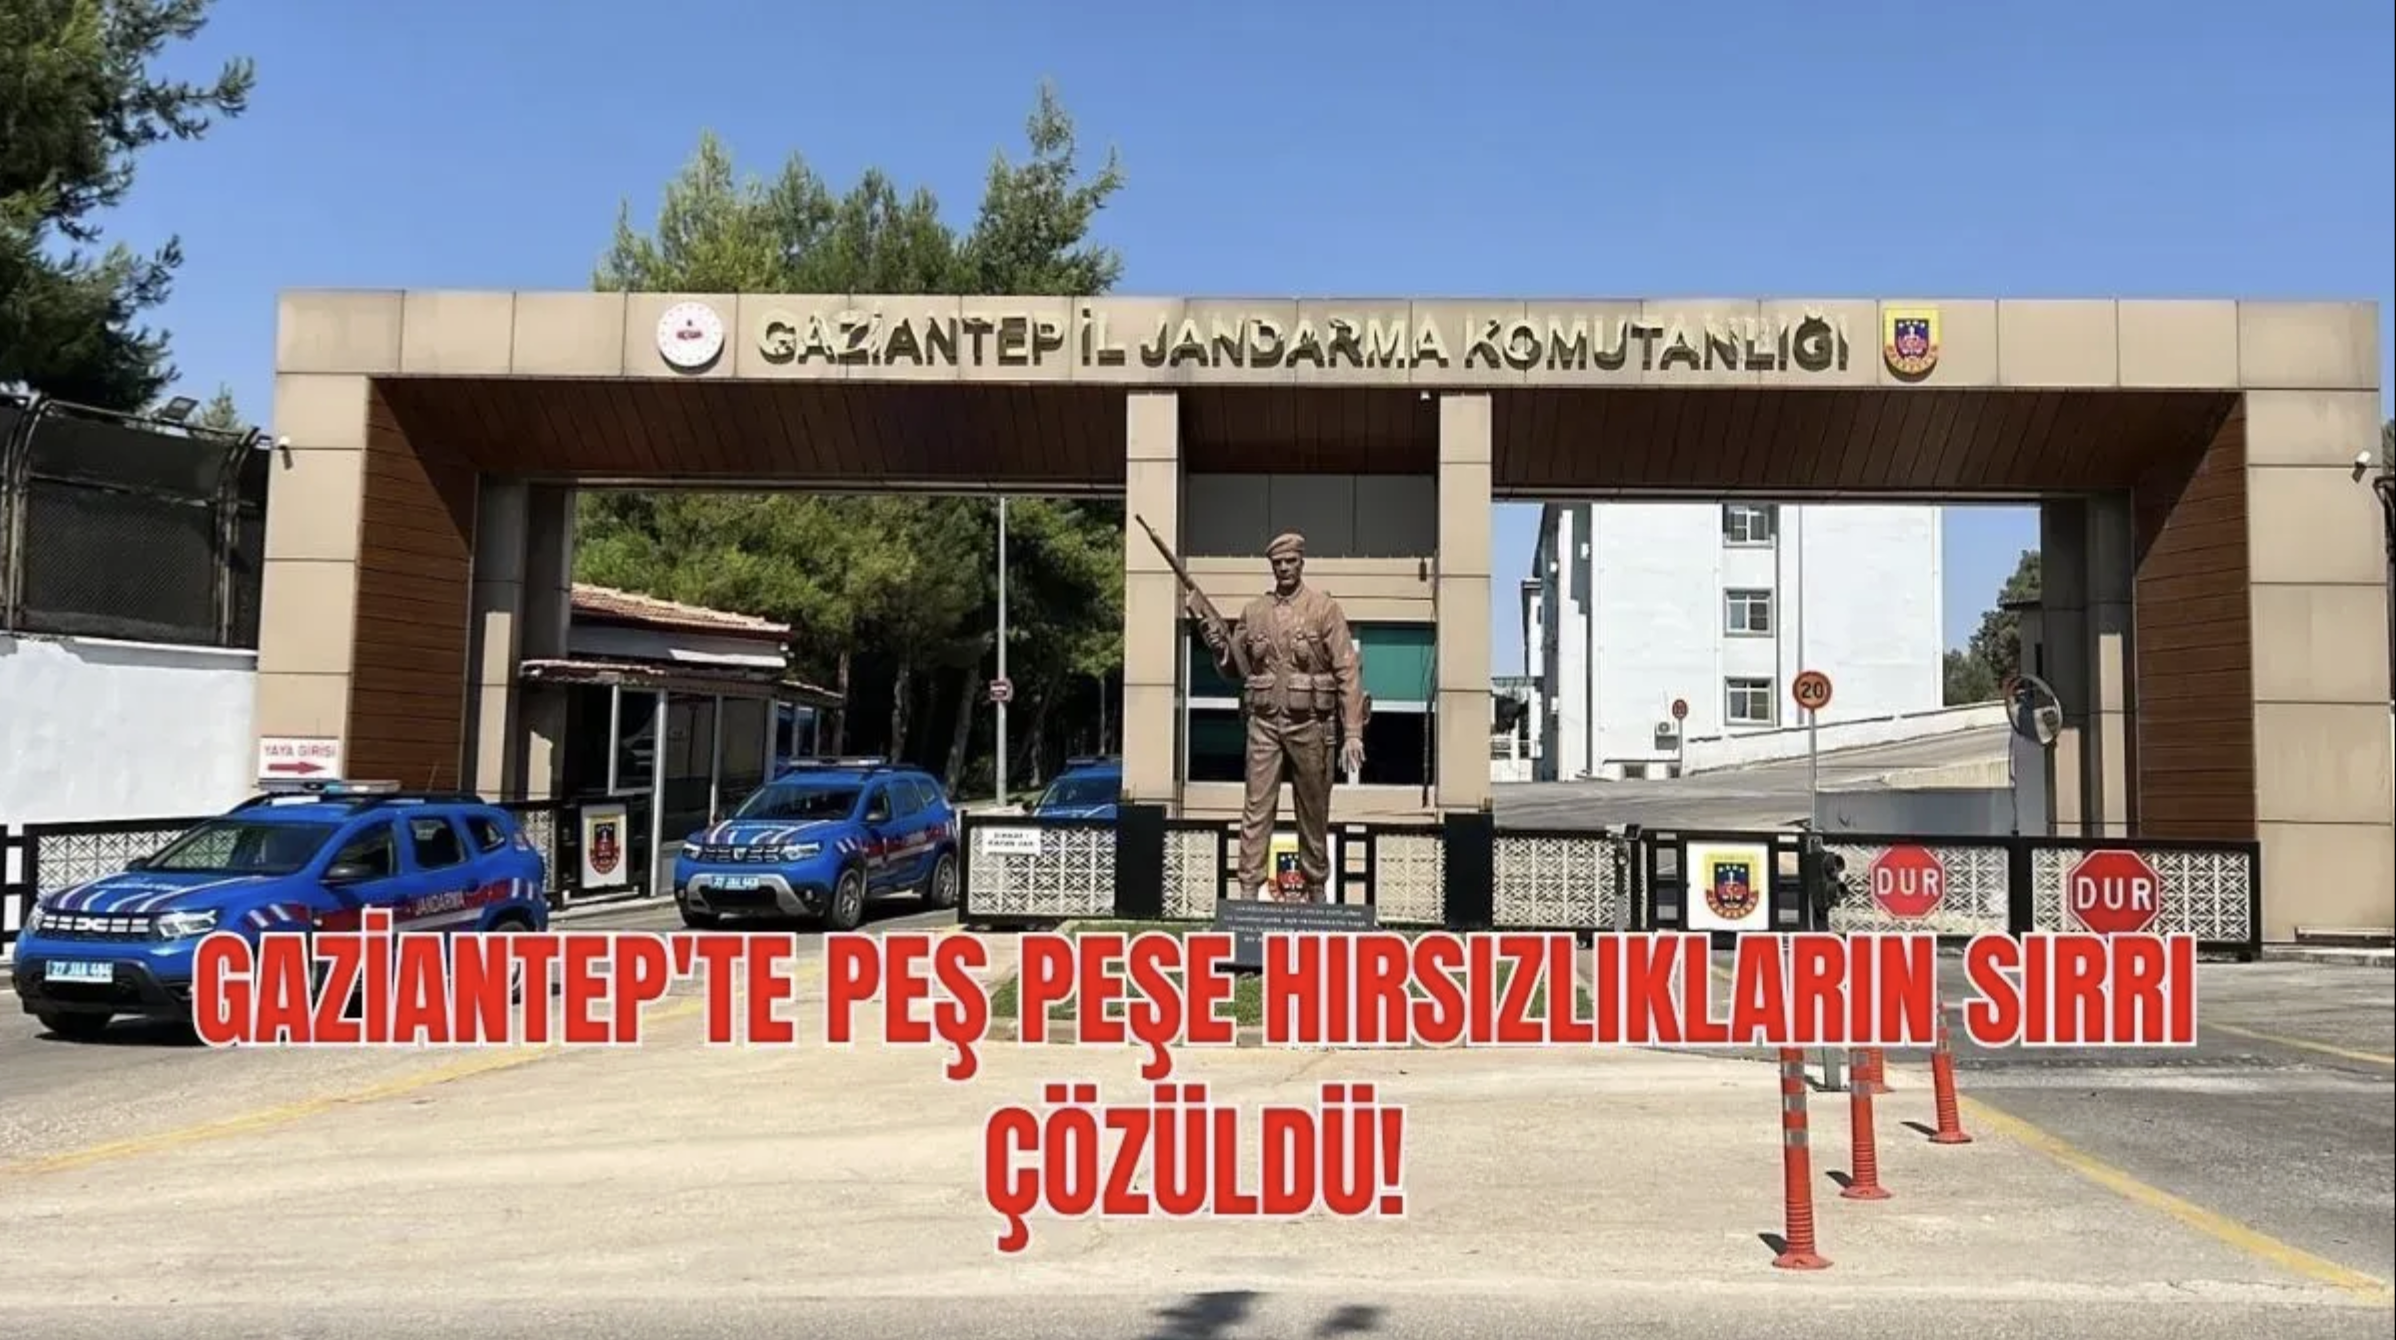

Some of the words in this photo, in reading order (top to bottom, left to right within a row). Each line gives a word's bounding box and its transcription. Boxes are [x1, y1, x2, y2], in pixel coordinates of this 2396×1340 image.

[756, 303, 1064, 366] GAZİANTEP
[1081, 304, 1126, 366] İL
[1139, 311, 1450, 369] JANDARMA
[1463, 304, 1850, 371] KOMUTANLIĞI
[1801, 680, 1824, 699] 20
[264, 745, 294, 757] YAYA
[1877, 867, 1940, 896] DUR
[2076, 876, 2153, 912] DUR
